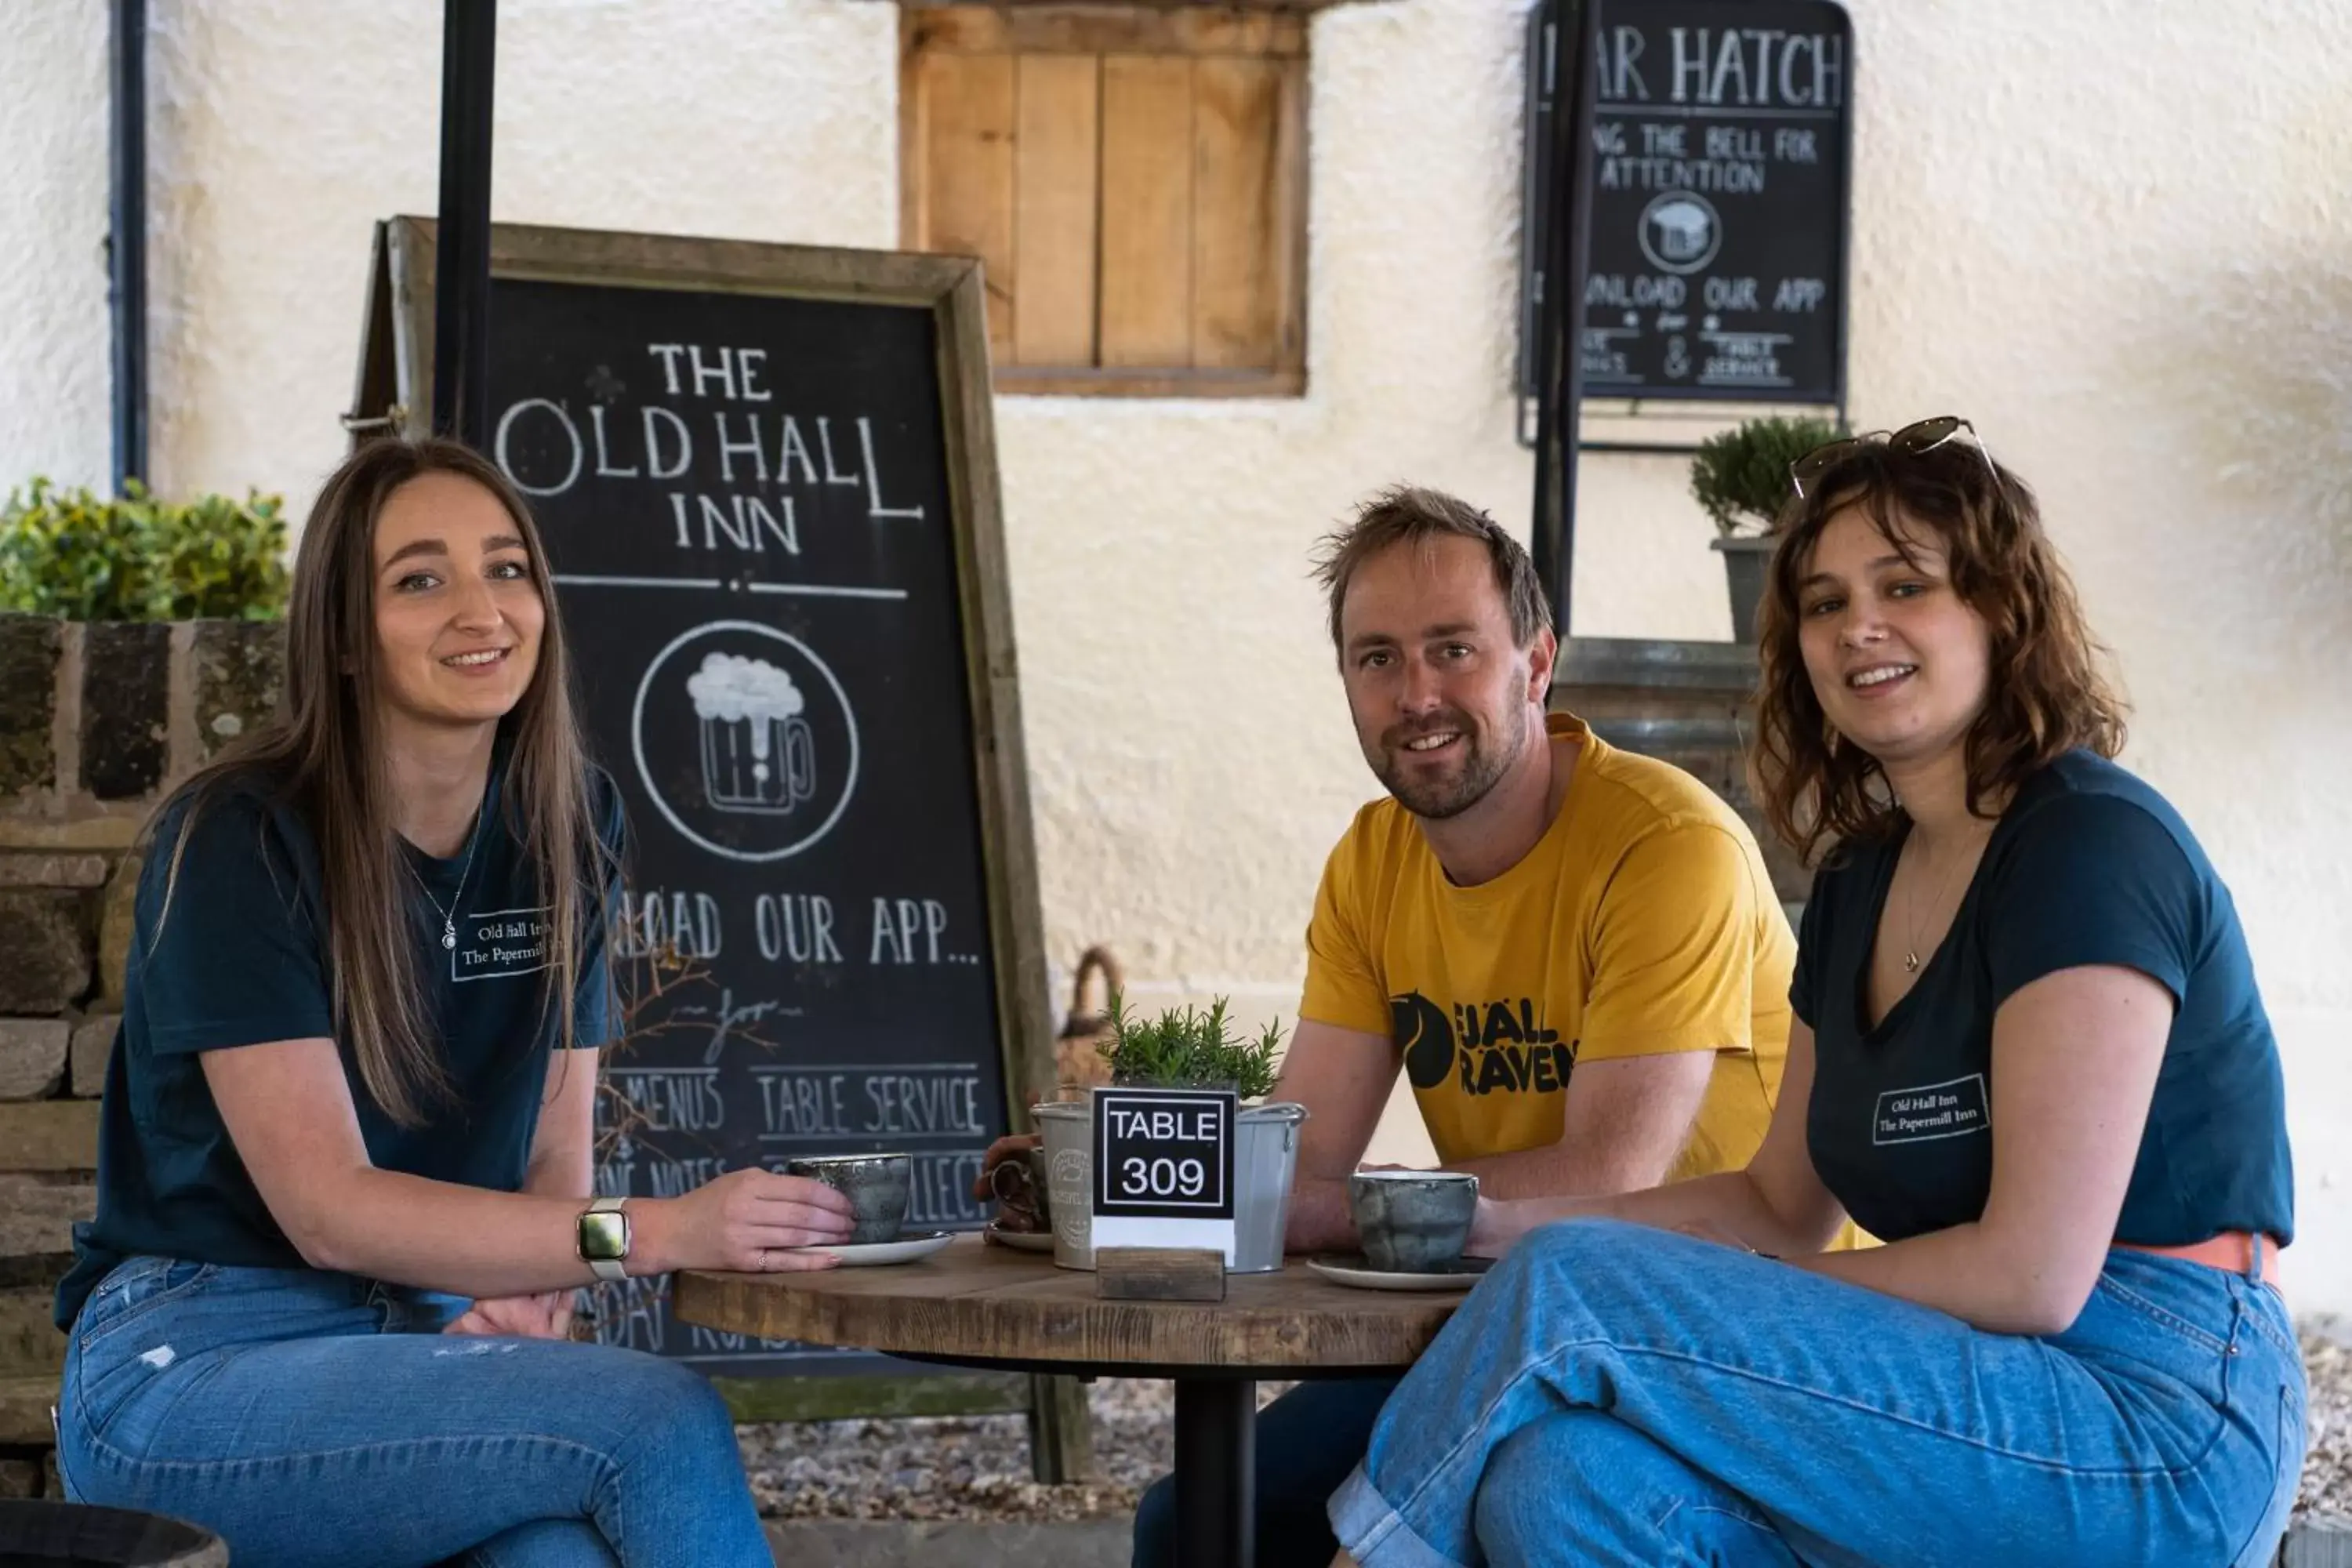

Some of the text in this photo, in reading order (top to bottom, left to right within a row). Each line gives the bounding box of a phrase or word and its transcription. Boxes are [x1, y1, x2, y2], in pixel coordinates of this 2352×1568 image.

[1670, 27, 1842, 106] HATCH
[1641, 123, 1688, 157] THE
[1706, 126, 1766, 159] BELL
[1599, 158, 1766, 194] ATTENTION
[1704, 278, 1759, 310] OUR
[1773, 278, 1825, 313] APP
[649, 344, 771, 401] THE
[495, 398, 924, 519] OLD HALL
[670, 493, 800, 554] INN
[478, 924, 503, 941] Old
[506, 921, 527, 938] Hall
[755, 894, 844, 963] OUR
[462, 949, 488, 965] The
[626, 1073, 725, 1131] MENUS
[757, 1076, 985, 1135] TABLE SERVICE
[1880, 1109, 1977, 1132] The Papermill Inn
[1892, 1095, 1958, 1112] Old Hall Inn
[1110, 1111, 1218, 1141] TABLE
[1122, 1157, 1205, 1196] 309
